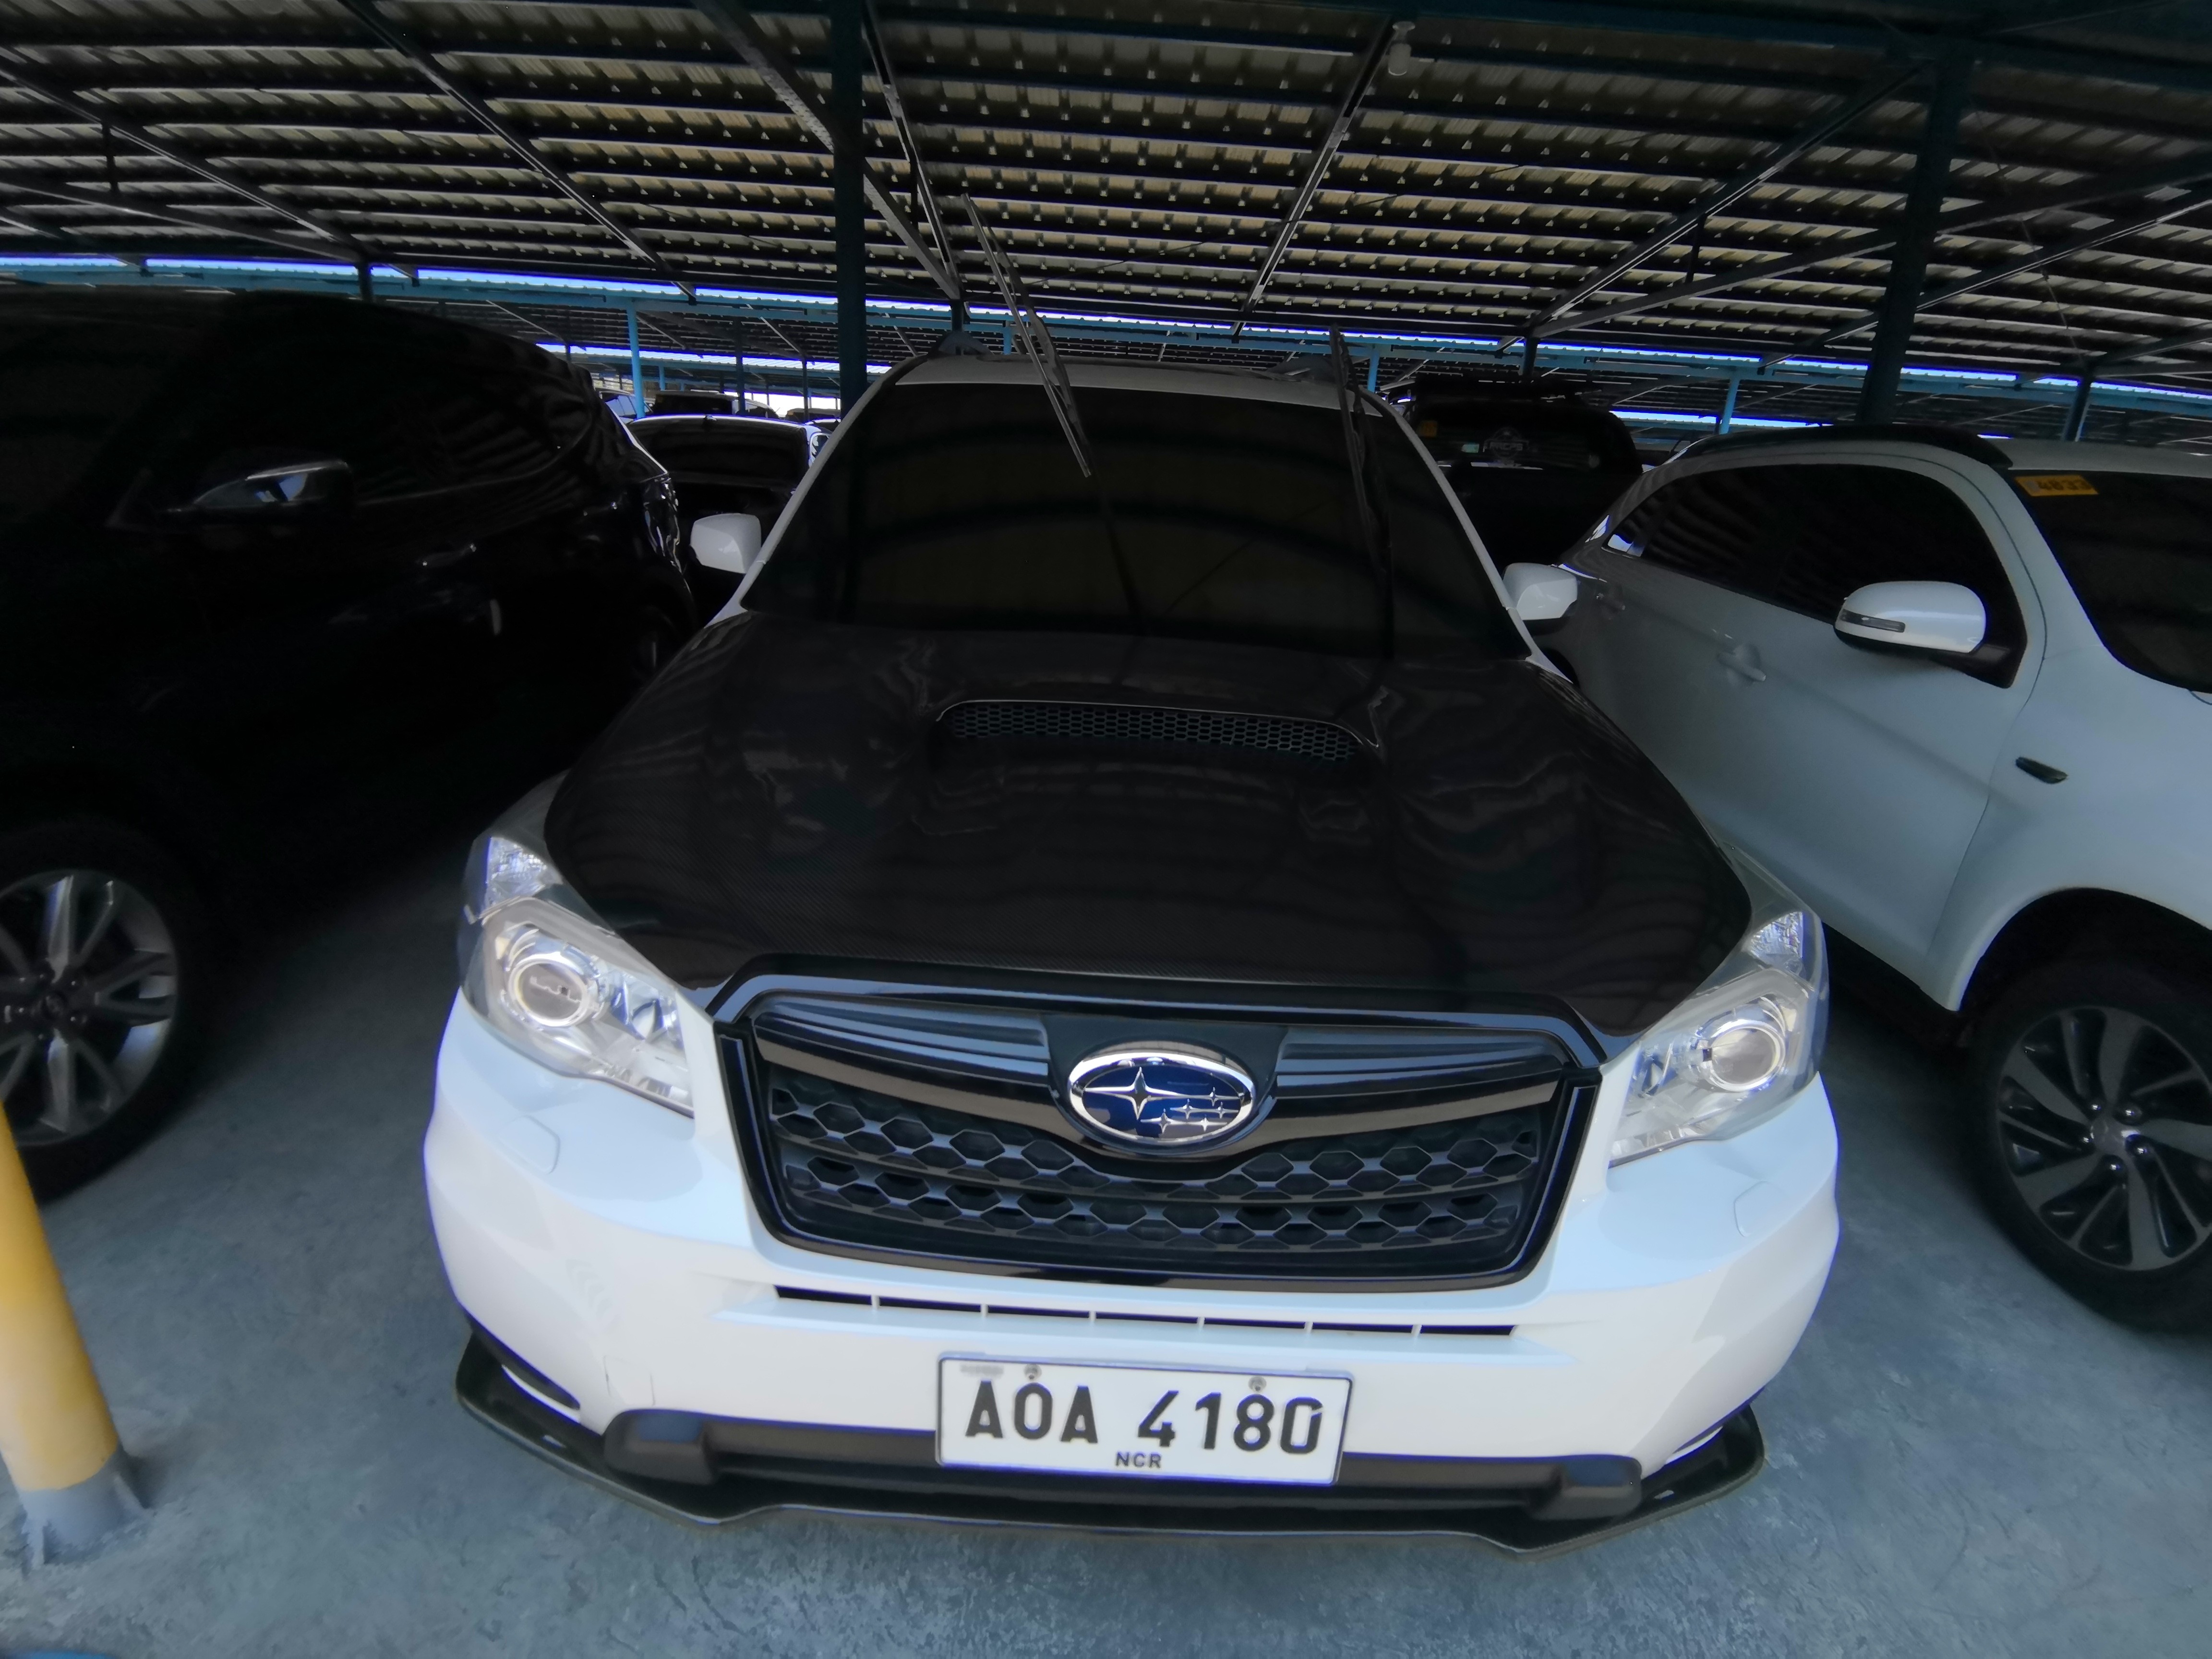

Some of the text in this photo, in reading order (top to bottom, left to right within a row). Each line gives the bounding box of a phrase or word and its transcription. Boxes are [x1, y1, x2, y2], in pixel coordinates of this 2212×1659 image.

[965, 1381, 1323, 1455] AOA 4180
[1116, 1452, 1161, 1468] NCR
